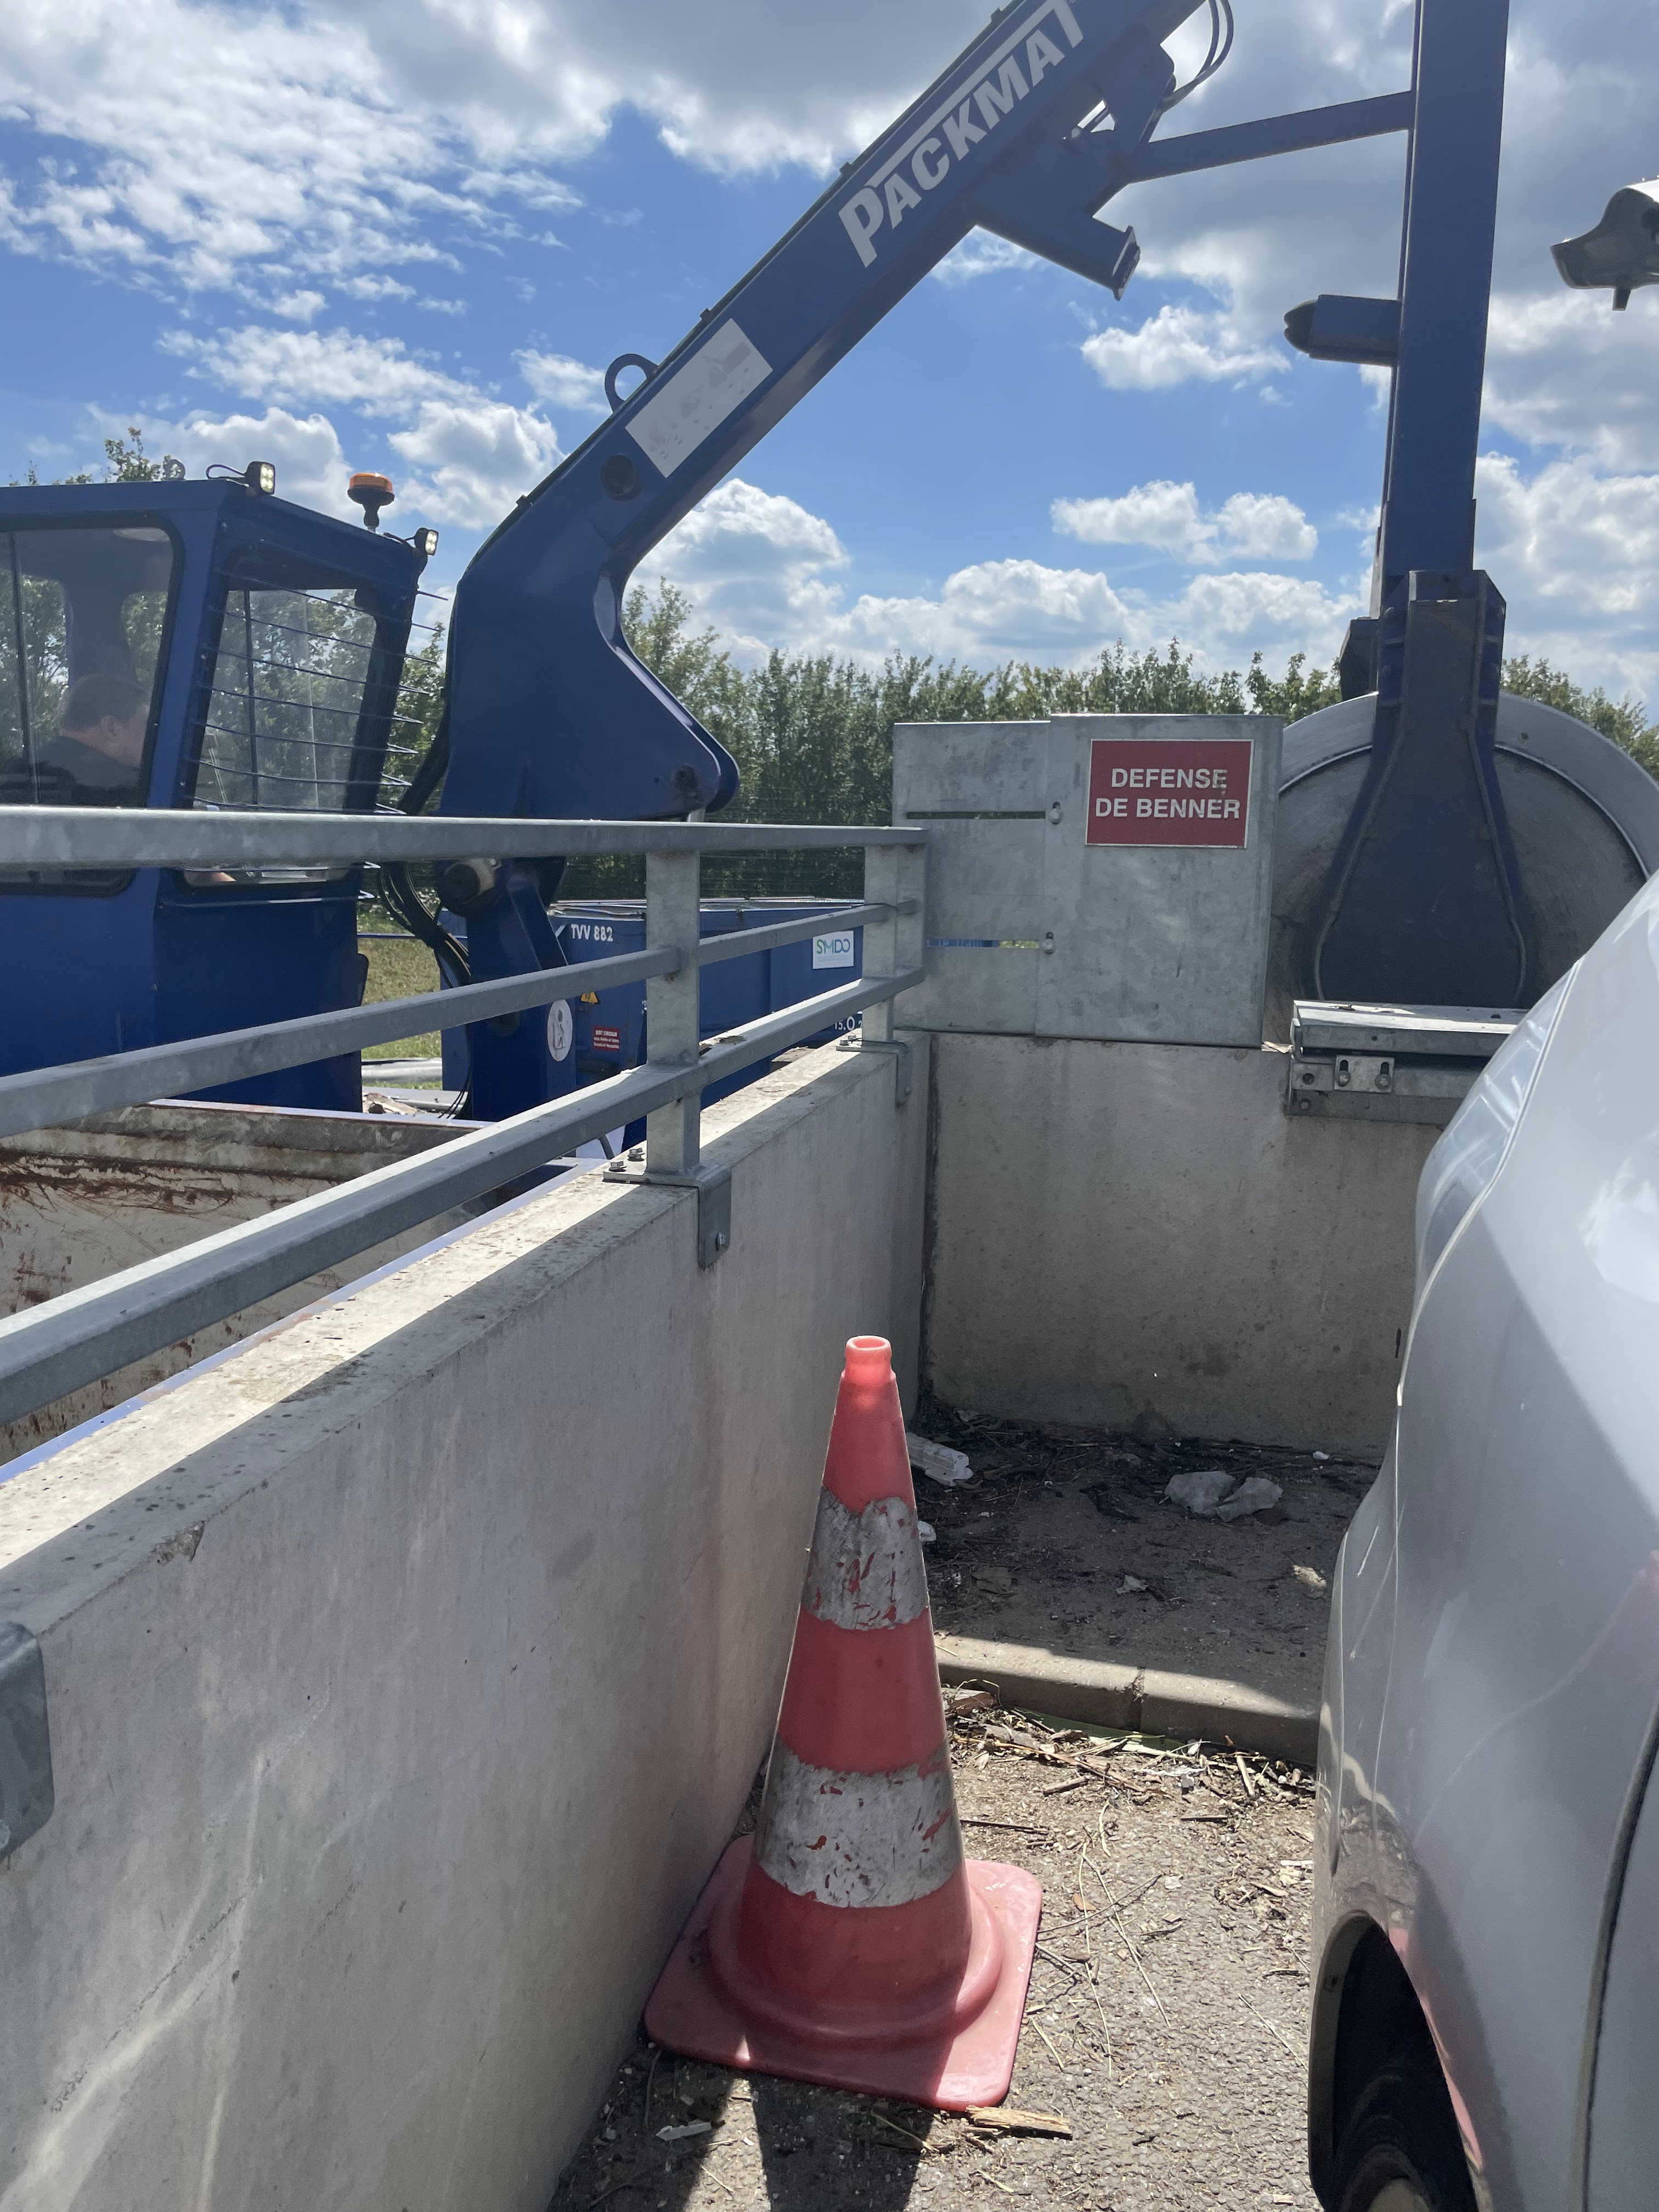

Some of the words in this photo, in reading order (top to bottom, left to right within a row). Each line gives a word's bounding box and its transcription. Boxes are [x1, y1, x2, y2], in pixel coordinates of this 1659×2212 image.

[838, 0, 1084, 268] PACKMAT
[1111, 768, 1228, 789] DEFENSE
[1096, 798, 1128, 817] DE
[1136, 798, 1240, 819] BENNER
[571, 924, 591, 940] TVV
[594, 926, 613, 942] 882
